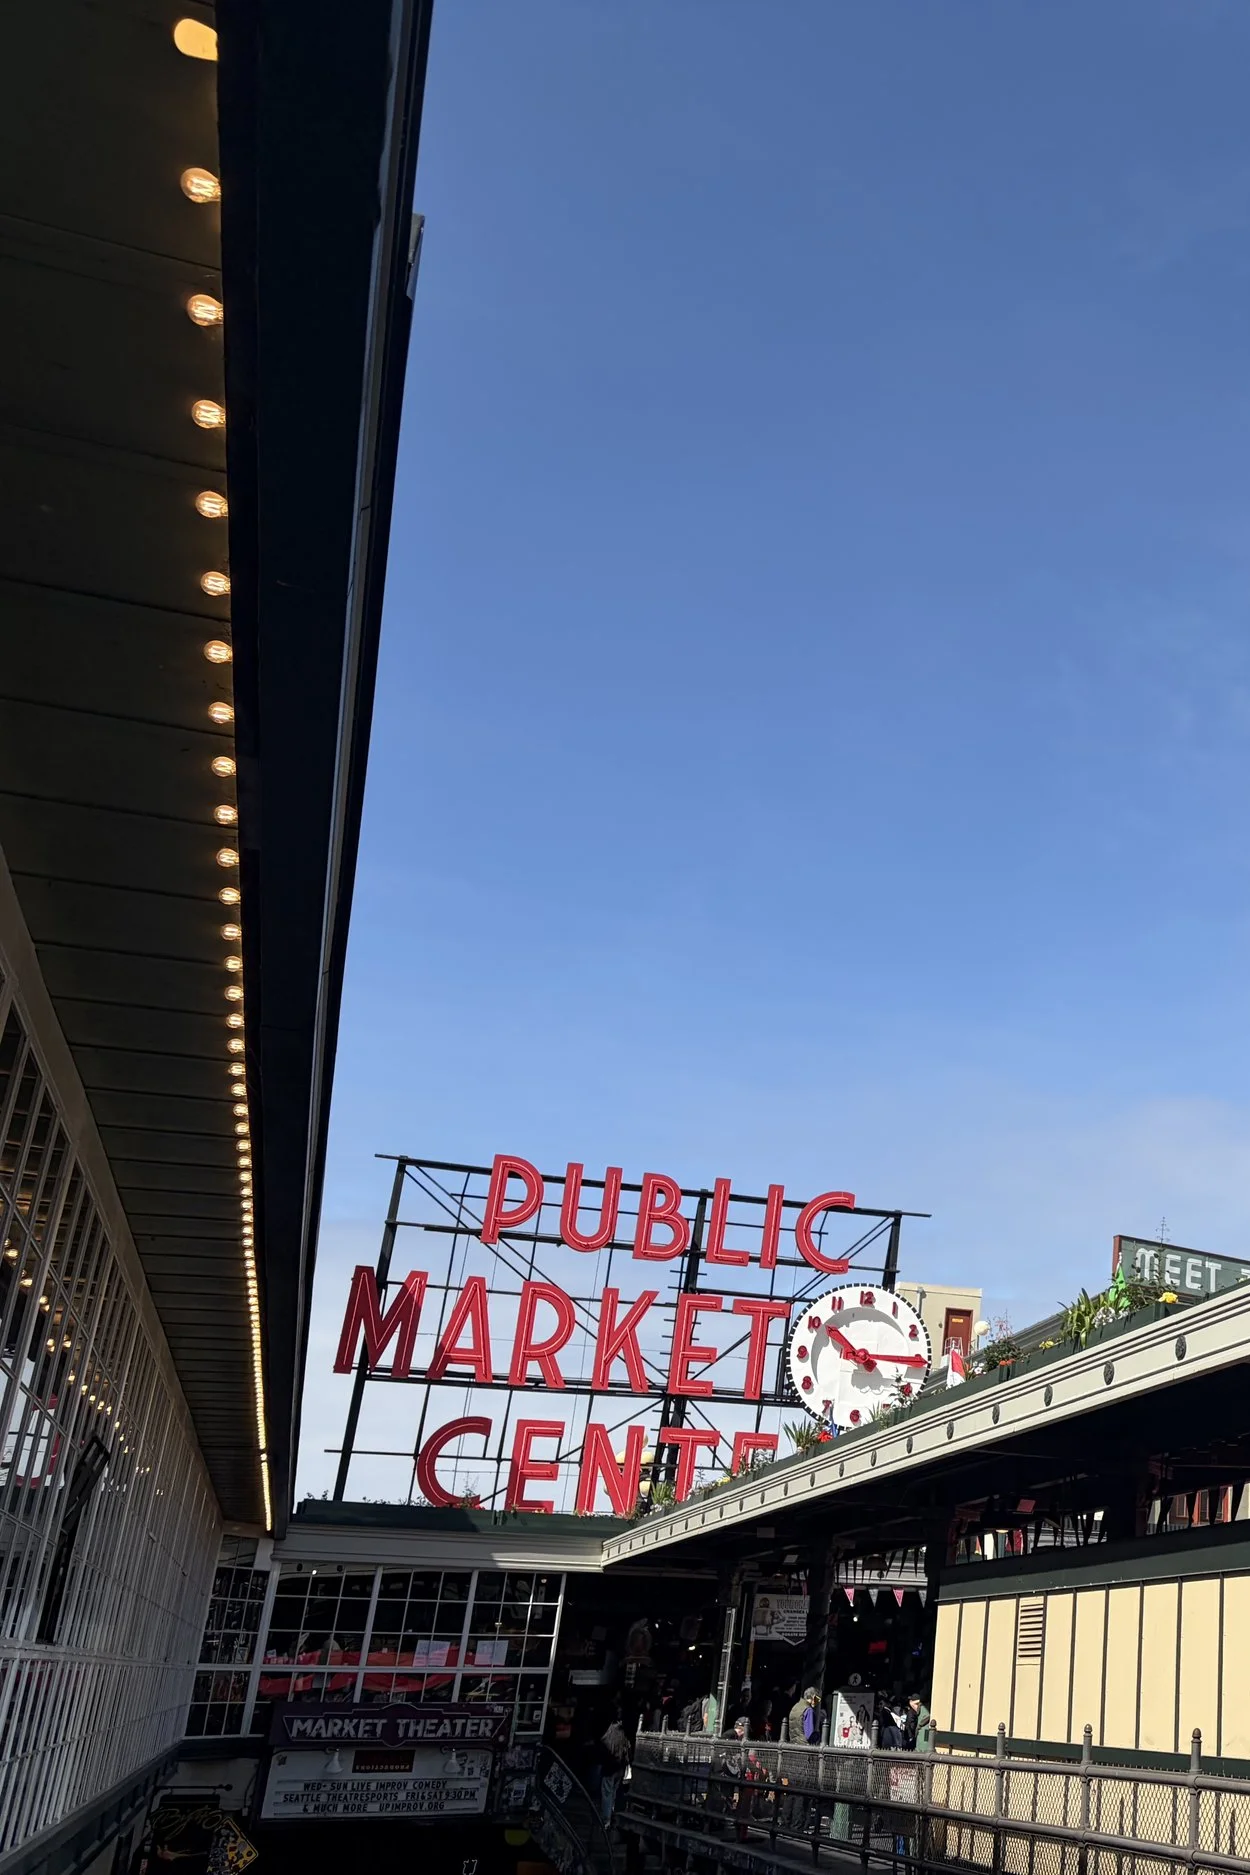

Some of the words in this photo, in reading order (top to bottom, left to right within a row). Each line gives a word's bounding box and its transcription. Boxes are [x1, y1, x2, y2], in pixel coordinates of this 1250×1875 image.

[480, 1153, 855, 1274] PUBLIC
[1135, 1247, 1222, 1293] MEET
[831, 1296, 843, 1310] 11
[860, 1290, 875, 1306] 12
[807, 1315, 821, 1329] 10
[333, 1265, 791, 1400] MARKET
[908, 1324, 918, 1338] 2
[797, 1345, 808, 1359] 9
[801, 1375, 812, 1390] 8
[291, 1717, 389, 1738] MARKET
[396, 1717, 495, 1738] THEATER
[330, 1782, 349, 1791] SUN
[351, 1781, 371, 1791] LIVE
[375, 1781, 408, 1791] IMPROV
[412, 1780, 448, 1790] COMEDY
[282, 1793, 321, 1803] SEATTLE
[326, 1792, 399, 1802] THEATRESPORTS
[313, 1803, 339, 1813] MUCH
[342, 1803, 368, 1812] MORE
